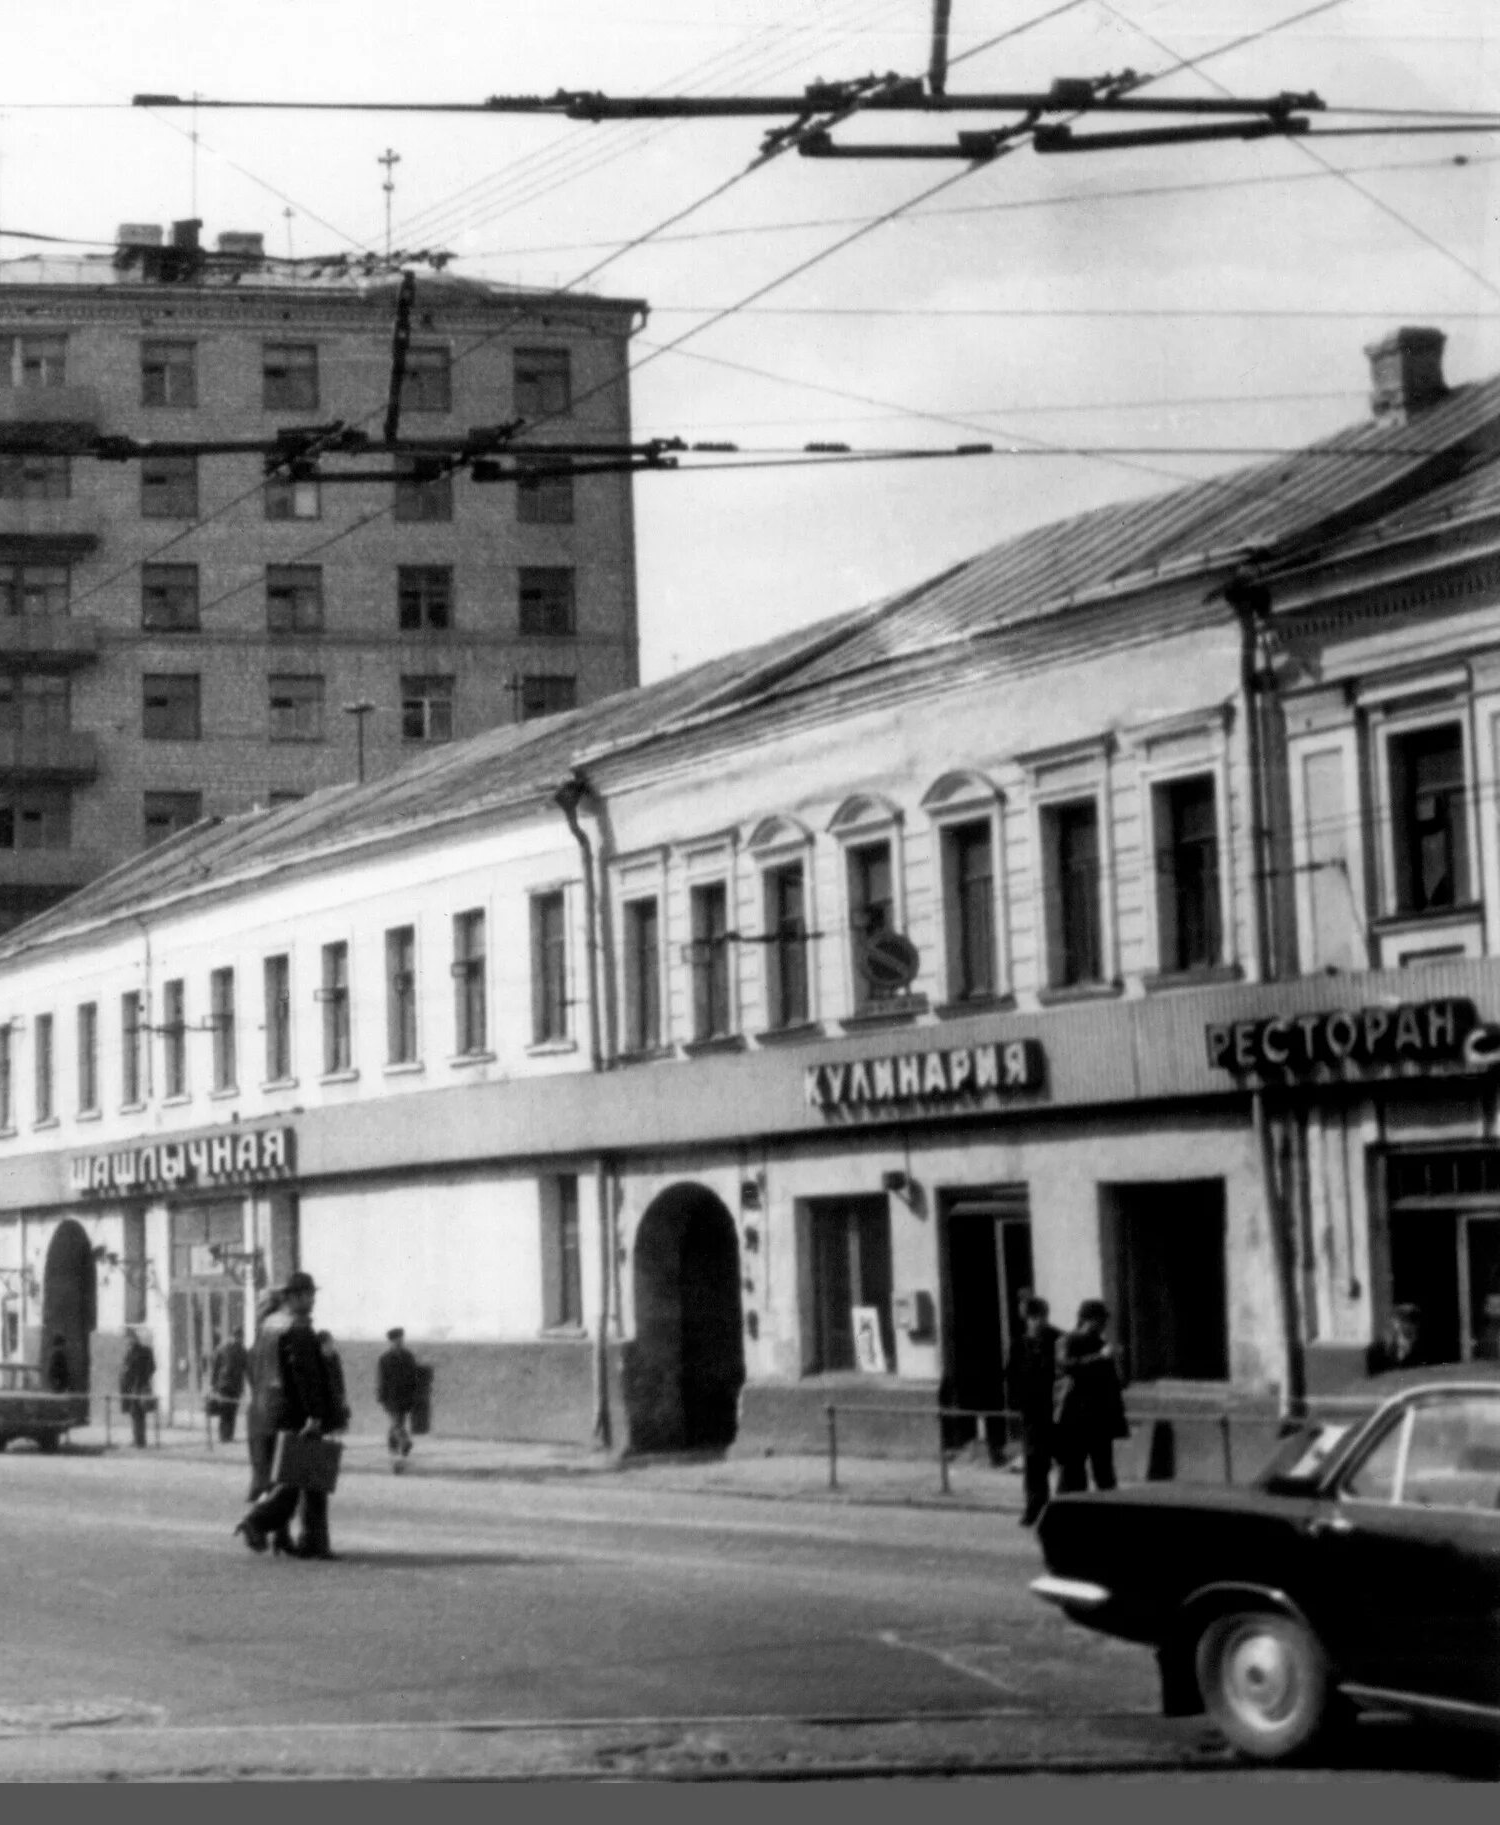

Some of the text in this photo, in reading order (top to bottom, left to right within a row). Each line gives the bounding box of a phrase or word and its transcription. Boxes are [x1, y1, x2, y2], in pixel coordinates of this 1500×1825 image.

[1207, 999, 1455, 1068] РЕСТОРАН
[803, 1041, 1028, 1105] КУЛИНАРИЯ
[69, 1127, 285, 1190] ШАШЛЫЧНАЯ
